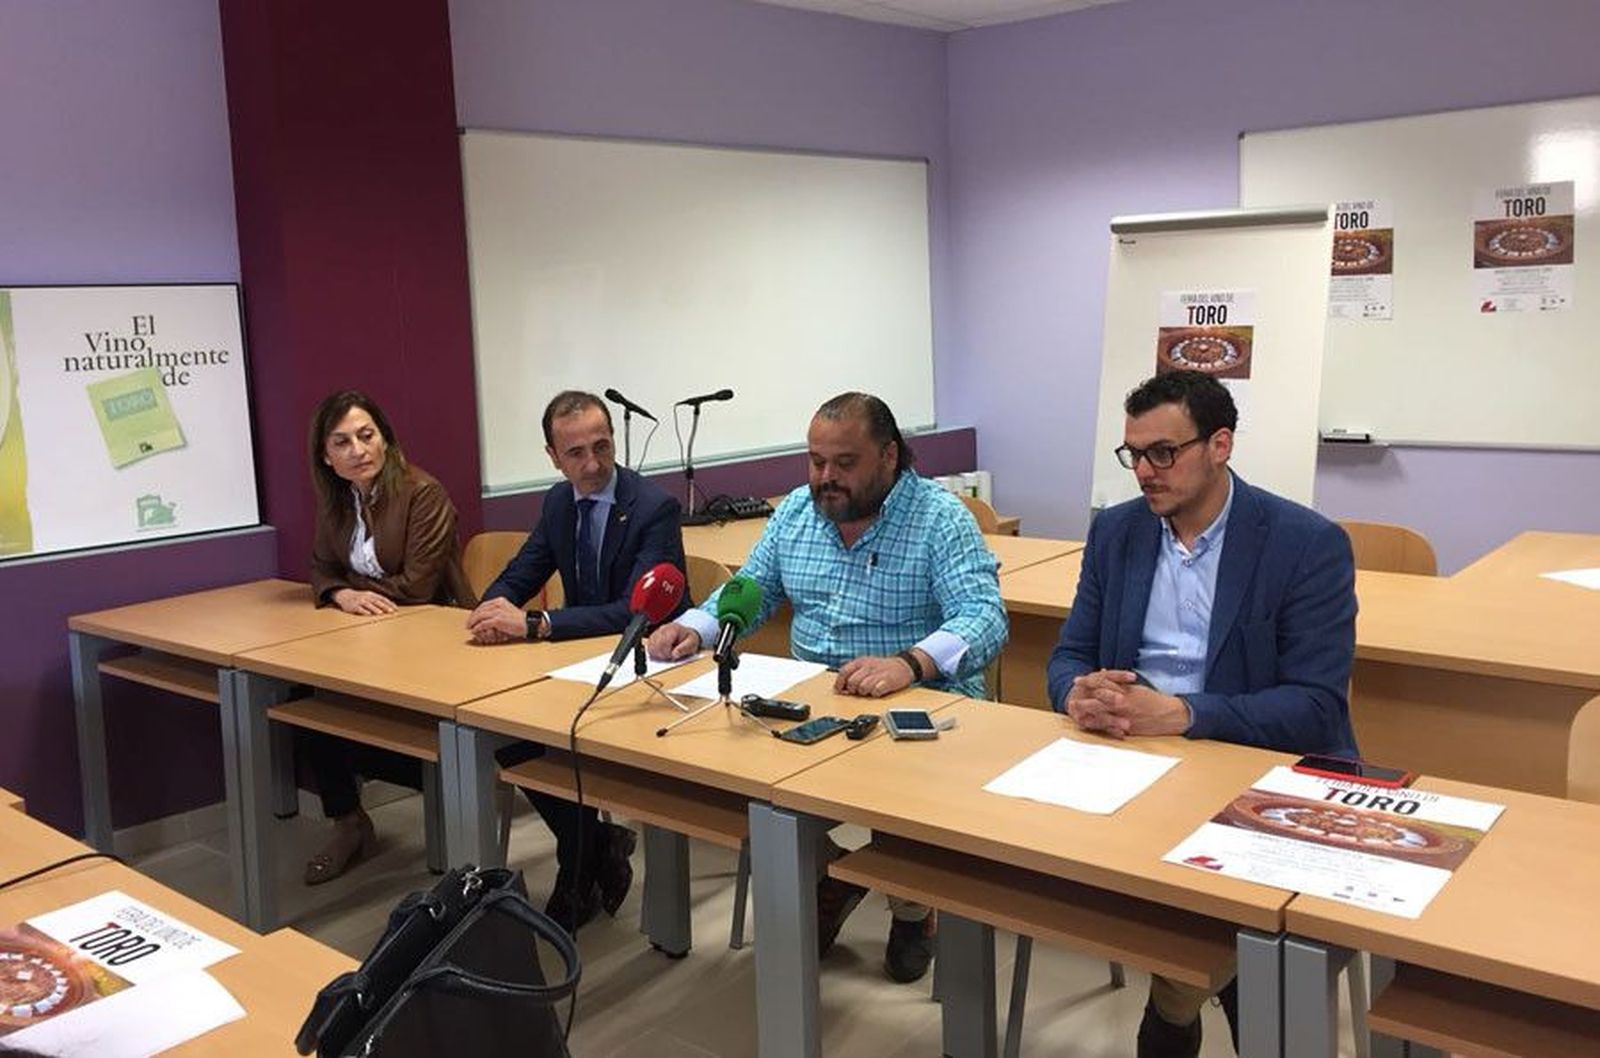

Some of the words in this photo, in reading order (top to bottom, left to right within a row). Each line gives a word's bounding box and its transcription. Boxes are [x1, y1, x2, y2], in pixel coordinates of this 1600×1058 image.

[1503, 196, 1546, 217] TORO
[1334, 211, 1369, 230] TORO
[1186, 304, 1228, 325] TORO
[132, 315, 155, 336] El
[64, 347, 229, 372] naturalmente
[161, 366, 190, 387] de
[1324, 787, 1421, 815] TORO
[68, 921, 162, 966] TORO
